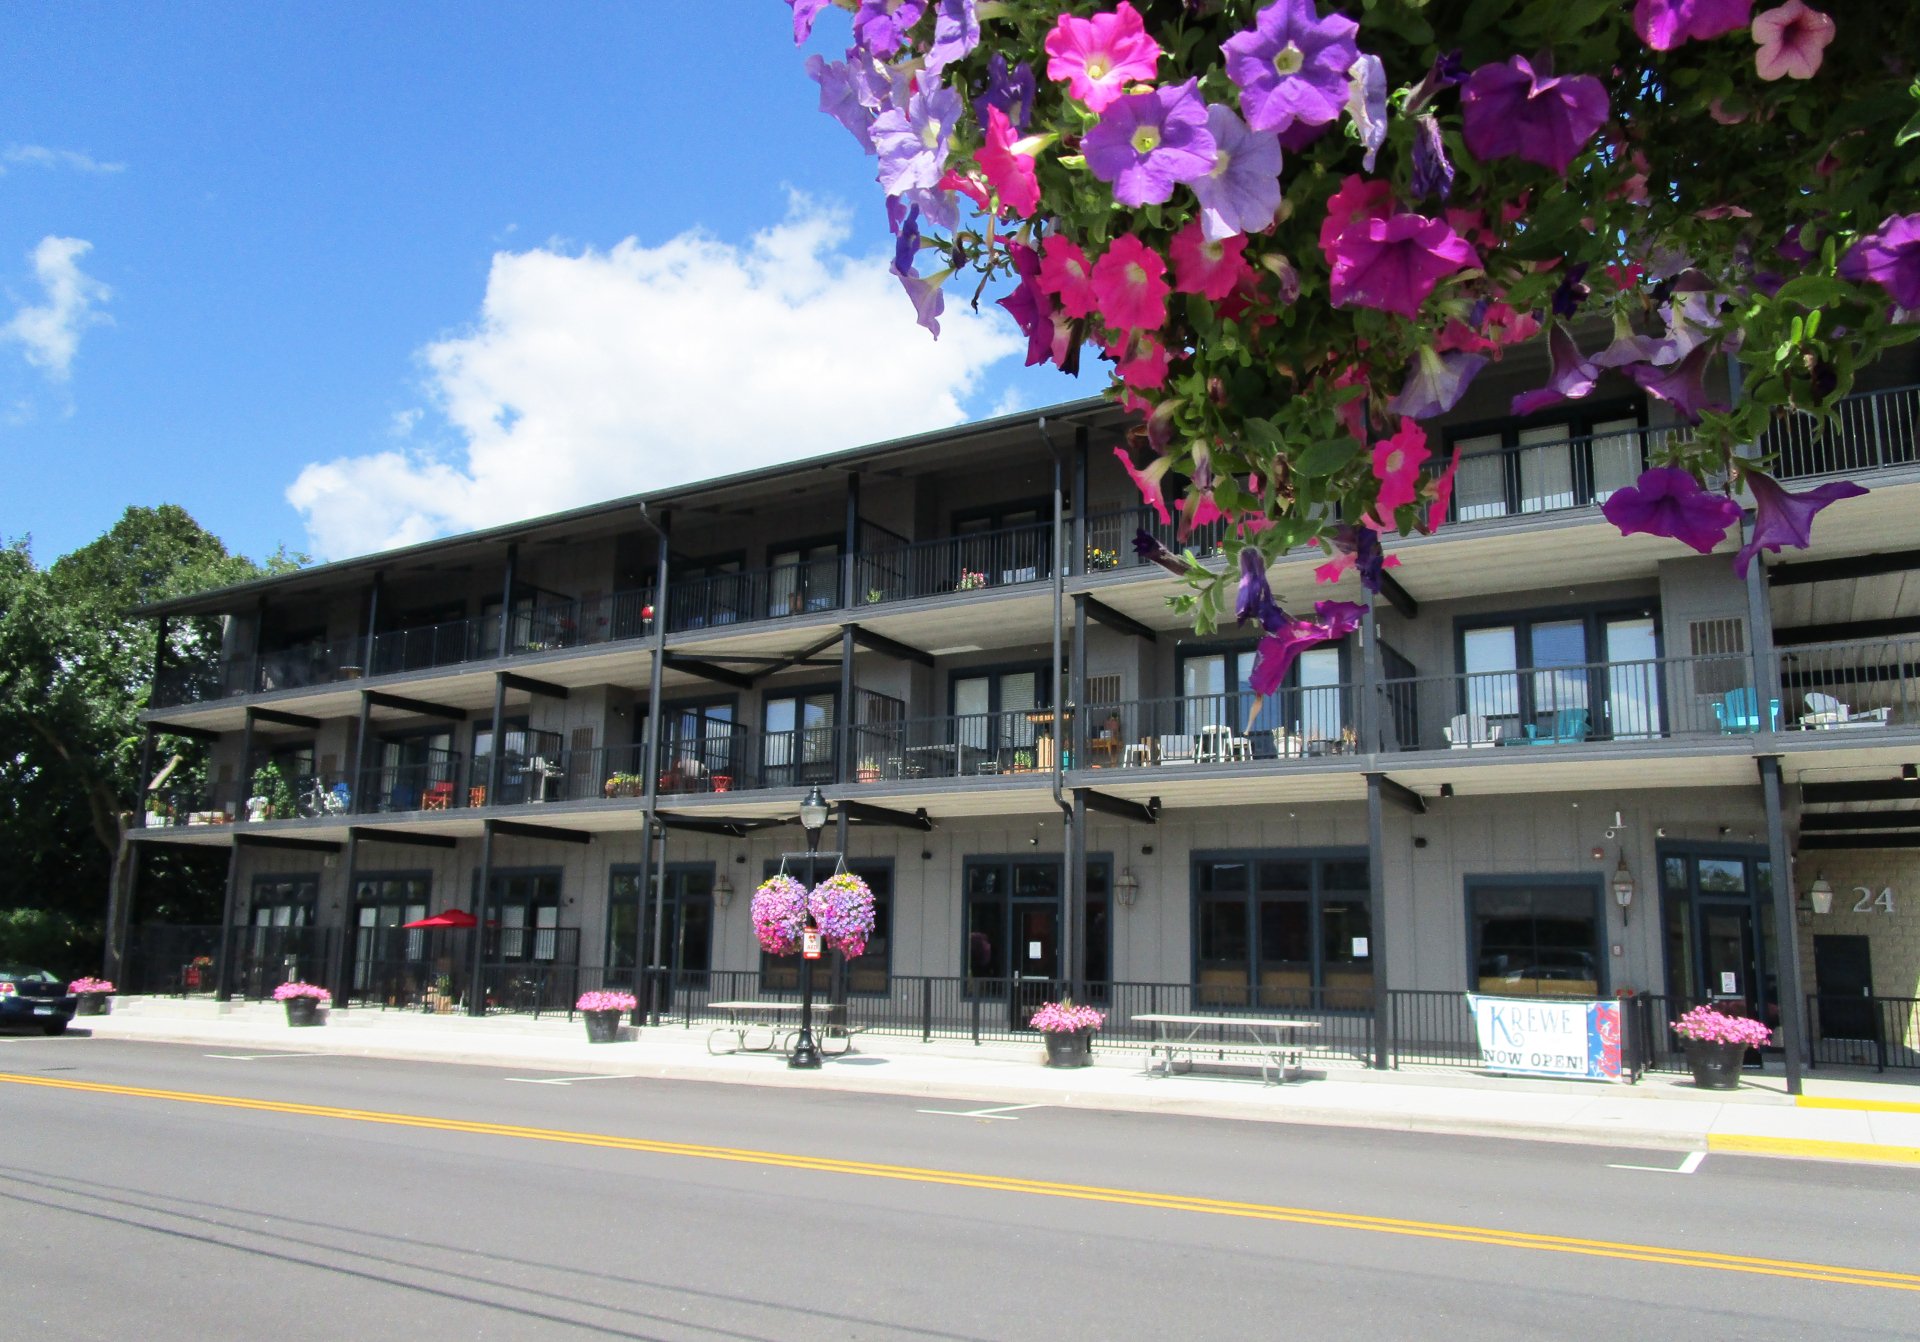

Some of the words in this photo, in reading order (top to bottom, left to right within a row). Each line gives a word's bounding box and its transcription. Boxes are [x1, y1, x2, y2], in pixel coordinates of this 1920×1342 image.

[1852, 886, 1895, 913] 24
[1490, 1006, 1573, 1047] KREWE
[1484, 1049, 1522, 1066] NOW
[1531, 1054, 1584, 1070] OPEN!
